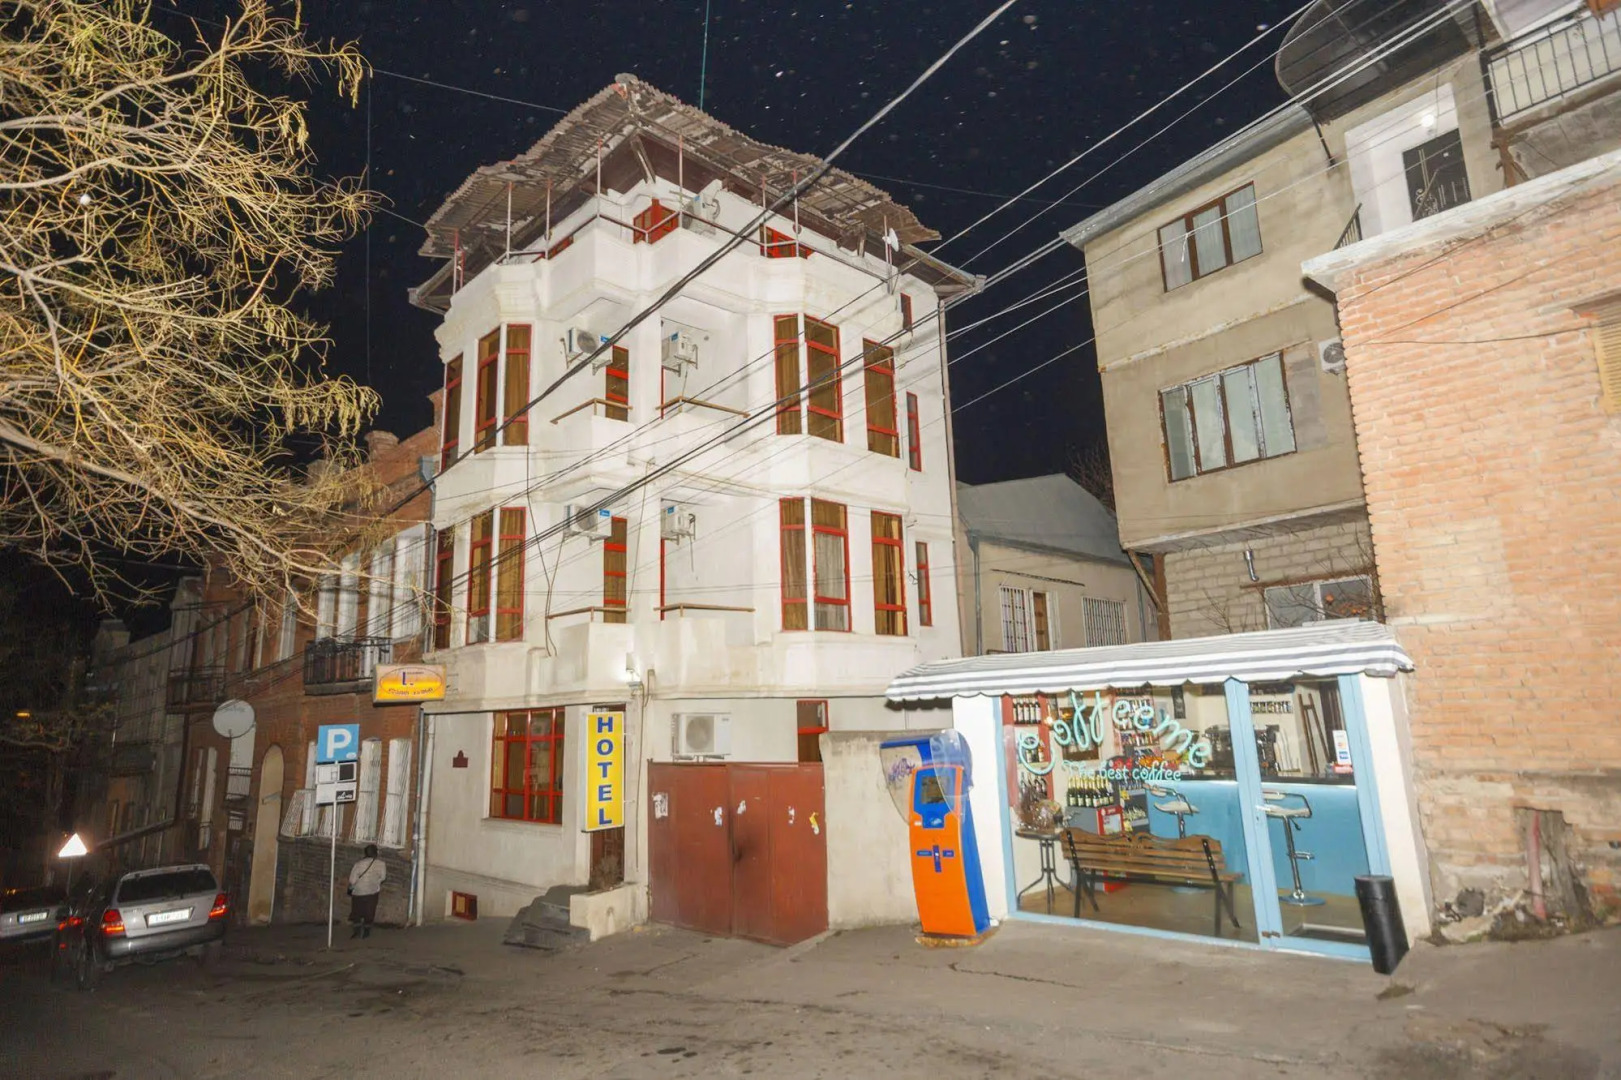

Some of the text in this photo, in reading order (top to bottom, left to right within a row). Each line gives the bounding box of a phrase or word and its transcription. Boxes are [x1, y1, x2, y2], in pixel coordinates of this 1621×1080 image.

[326, 728, 352, 759] P
[596, 716, 614, 826] HOTEL
[1100, 759, 1130, 783] best
[1132, 760, 1182, 781] coffee
